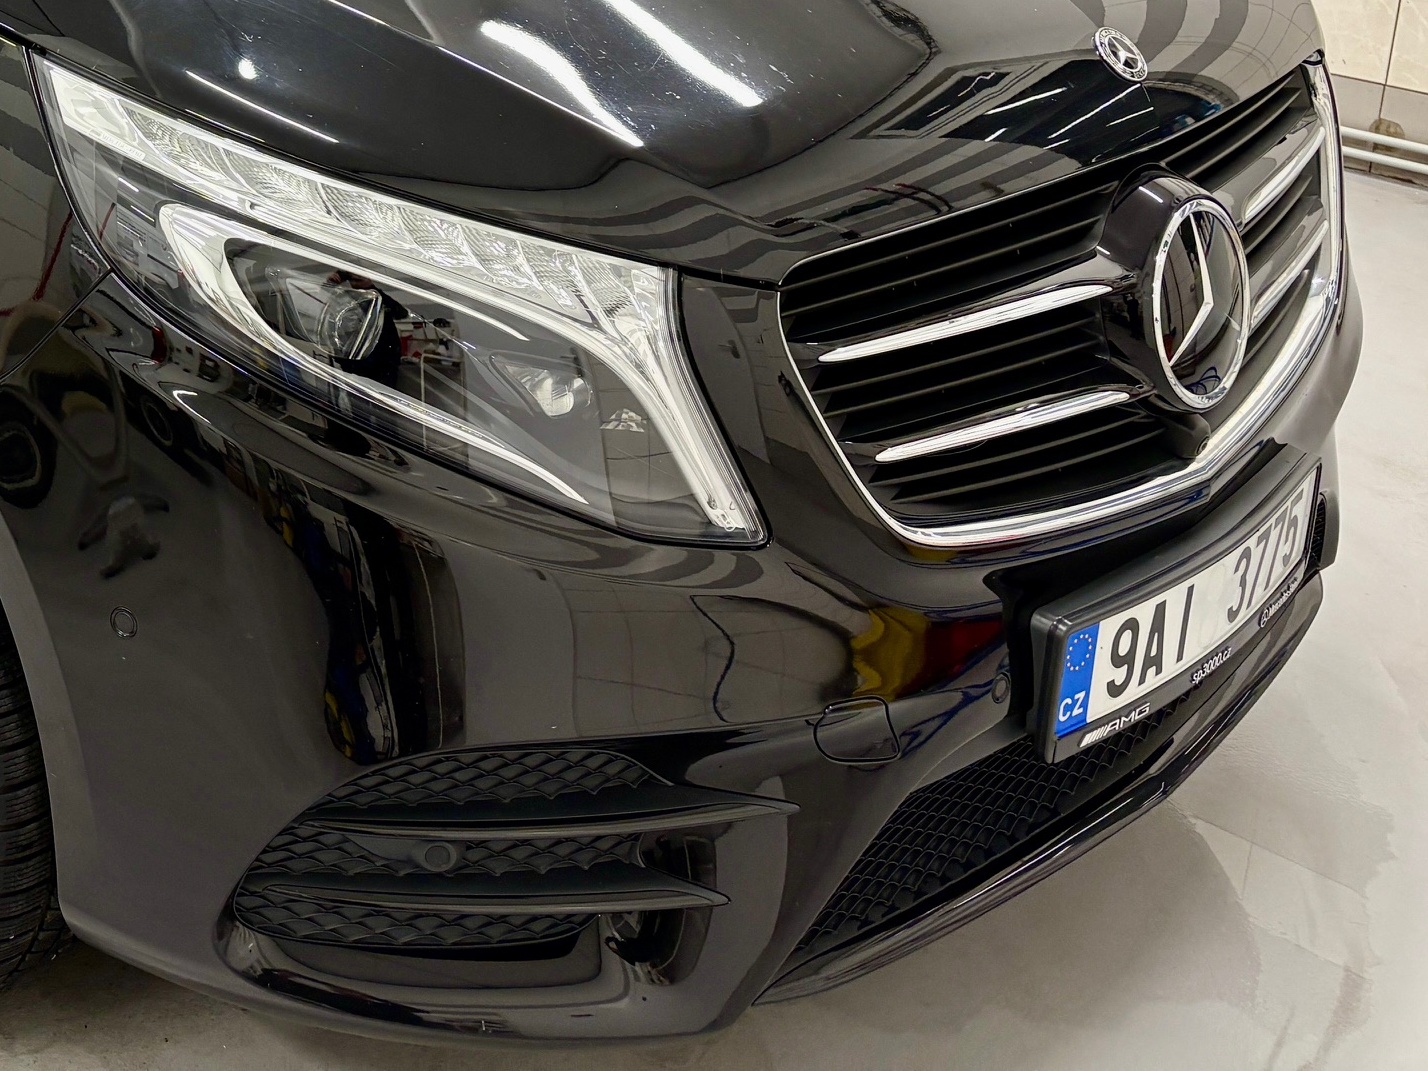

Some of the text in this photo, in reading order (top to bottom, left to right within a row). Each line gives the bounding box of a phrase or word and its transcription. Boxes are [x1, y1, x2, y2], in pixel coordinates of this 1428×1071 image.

[1106, 490, 1304, 698] 9AI 3775
[1191, 646, 1233, 685] sp3000.cz
[1058, 690, 1085, 722] CZ
[1105, 703, 1151, 737] AMG
